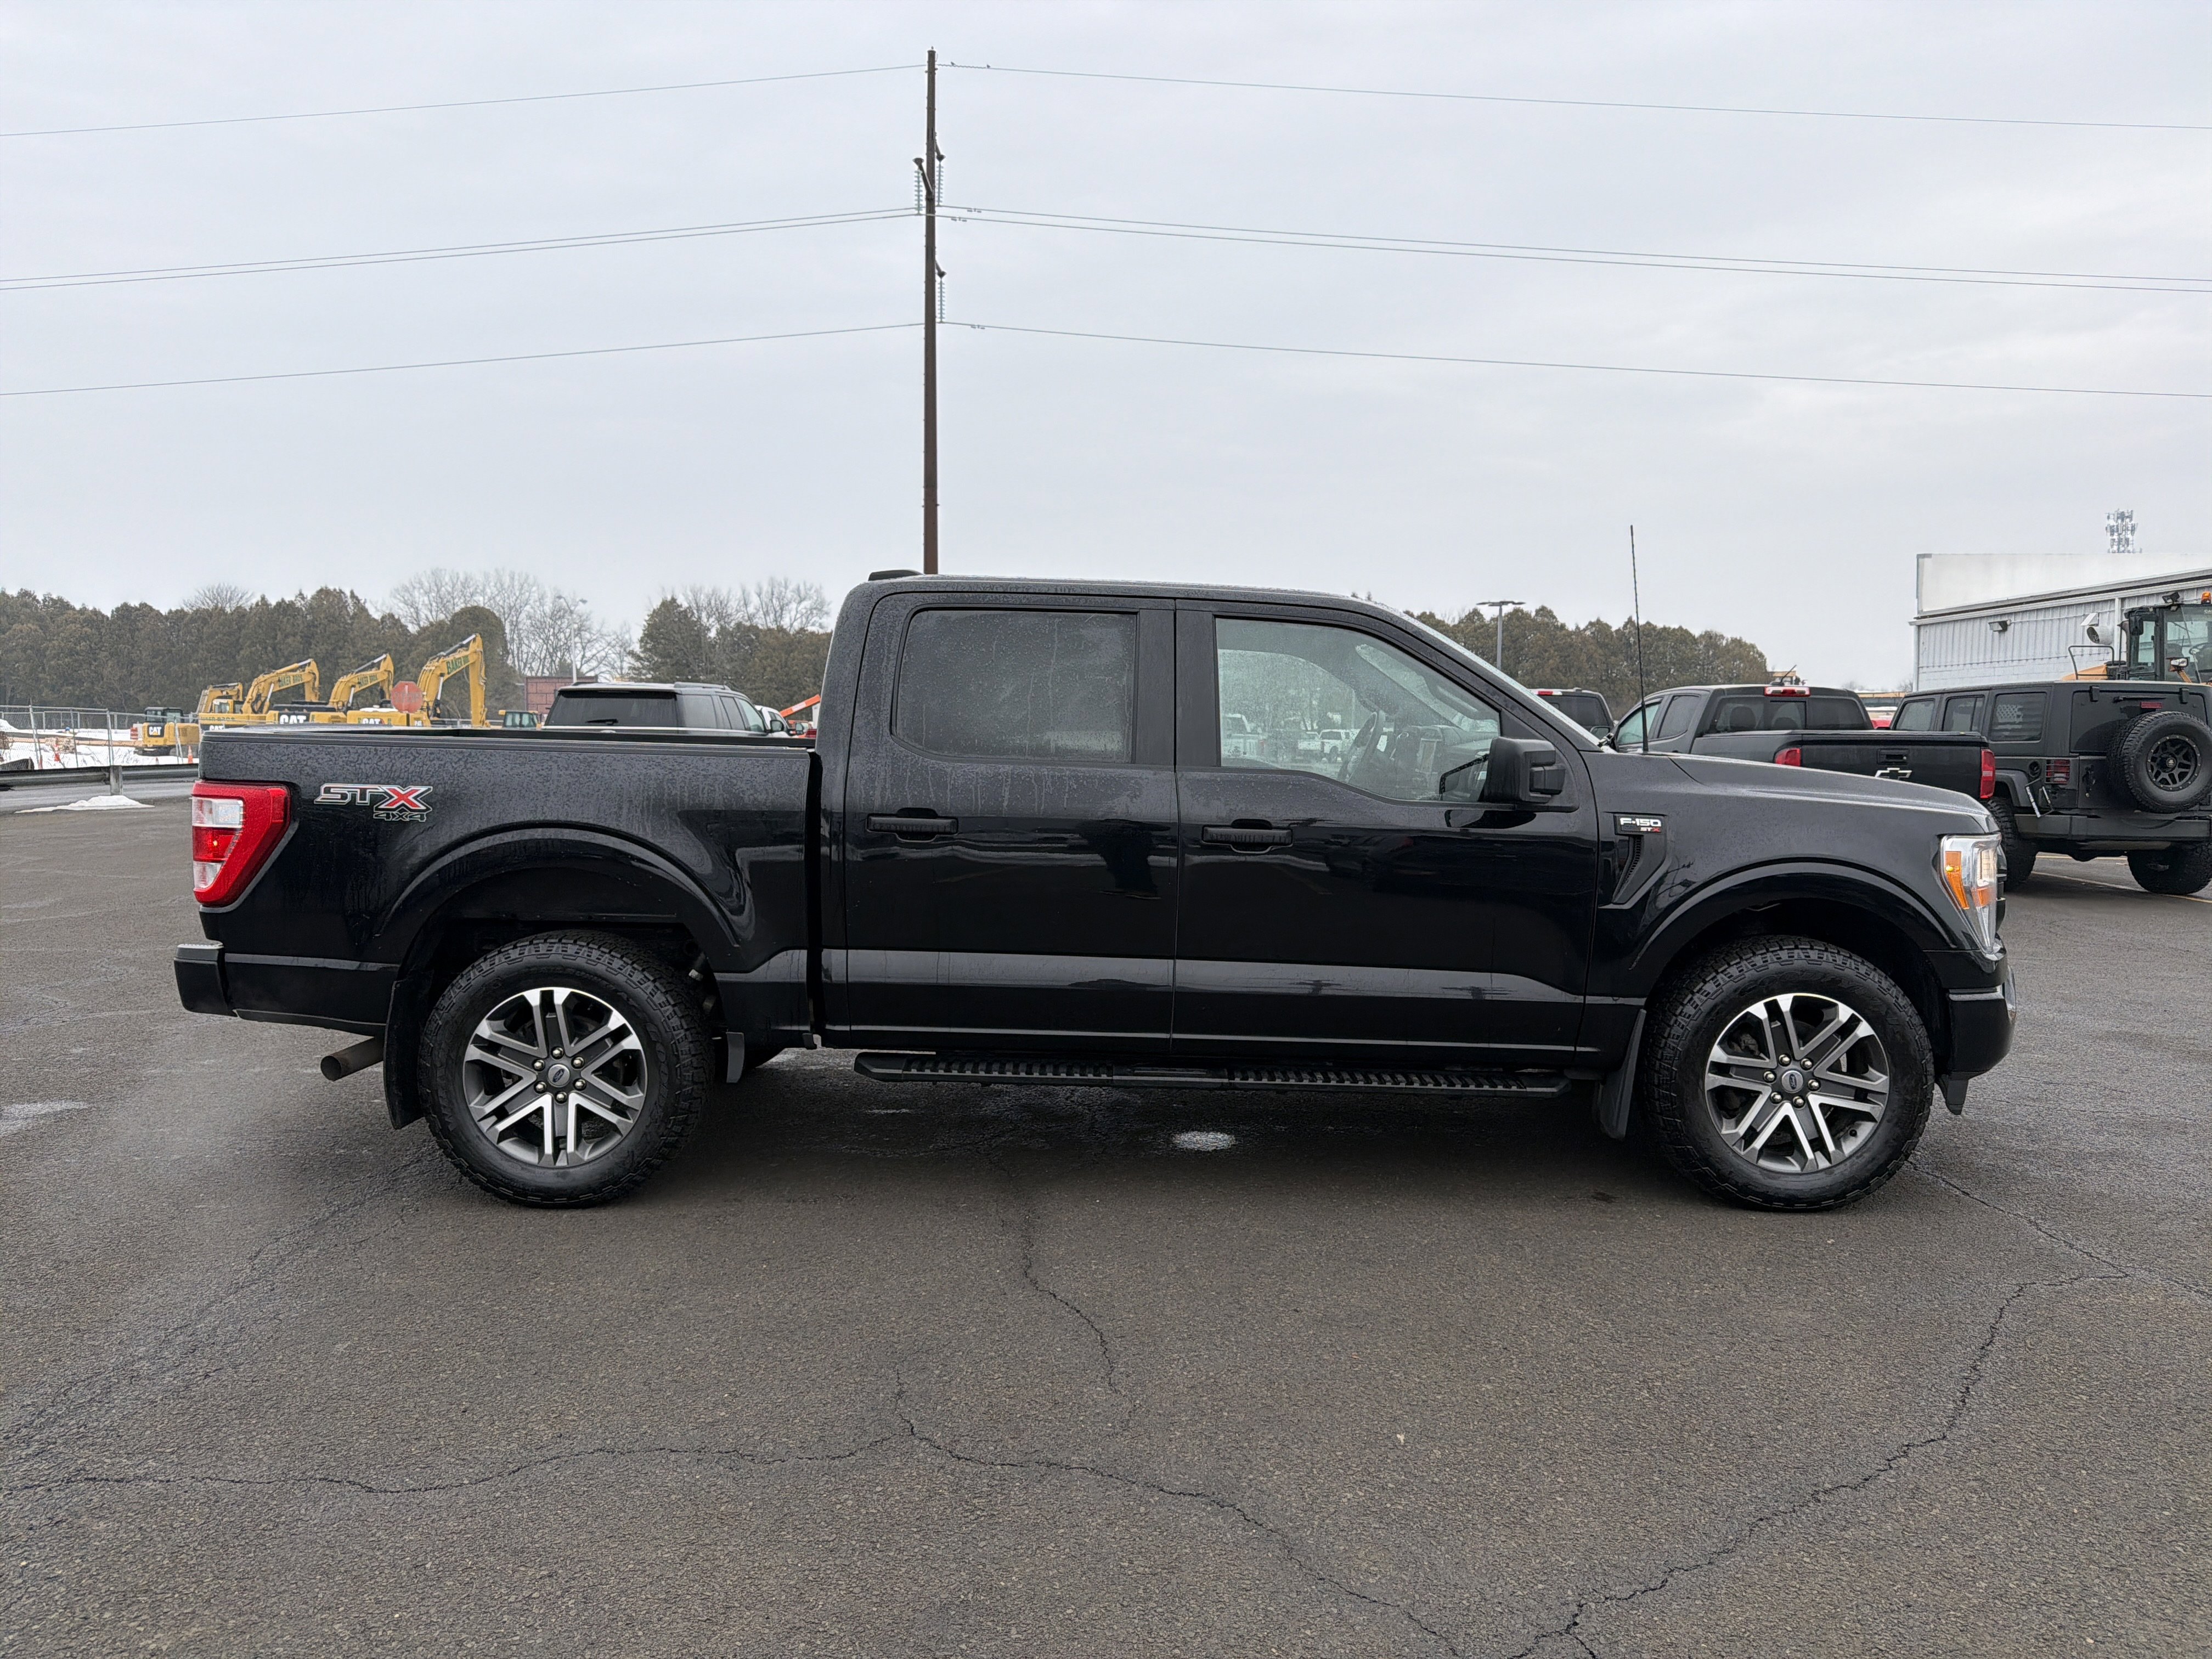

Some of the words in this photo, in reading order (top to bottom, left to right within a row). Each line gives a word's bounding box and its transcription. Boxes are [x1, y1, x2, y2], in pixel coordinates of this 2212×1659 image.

[279, 714, 307, 724] CAT
[149, 726, 162, 735] CAT
[314, 783, 433, 813] STX
[1620, 817, 1661, 827] F-150
